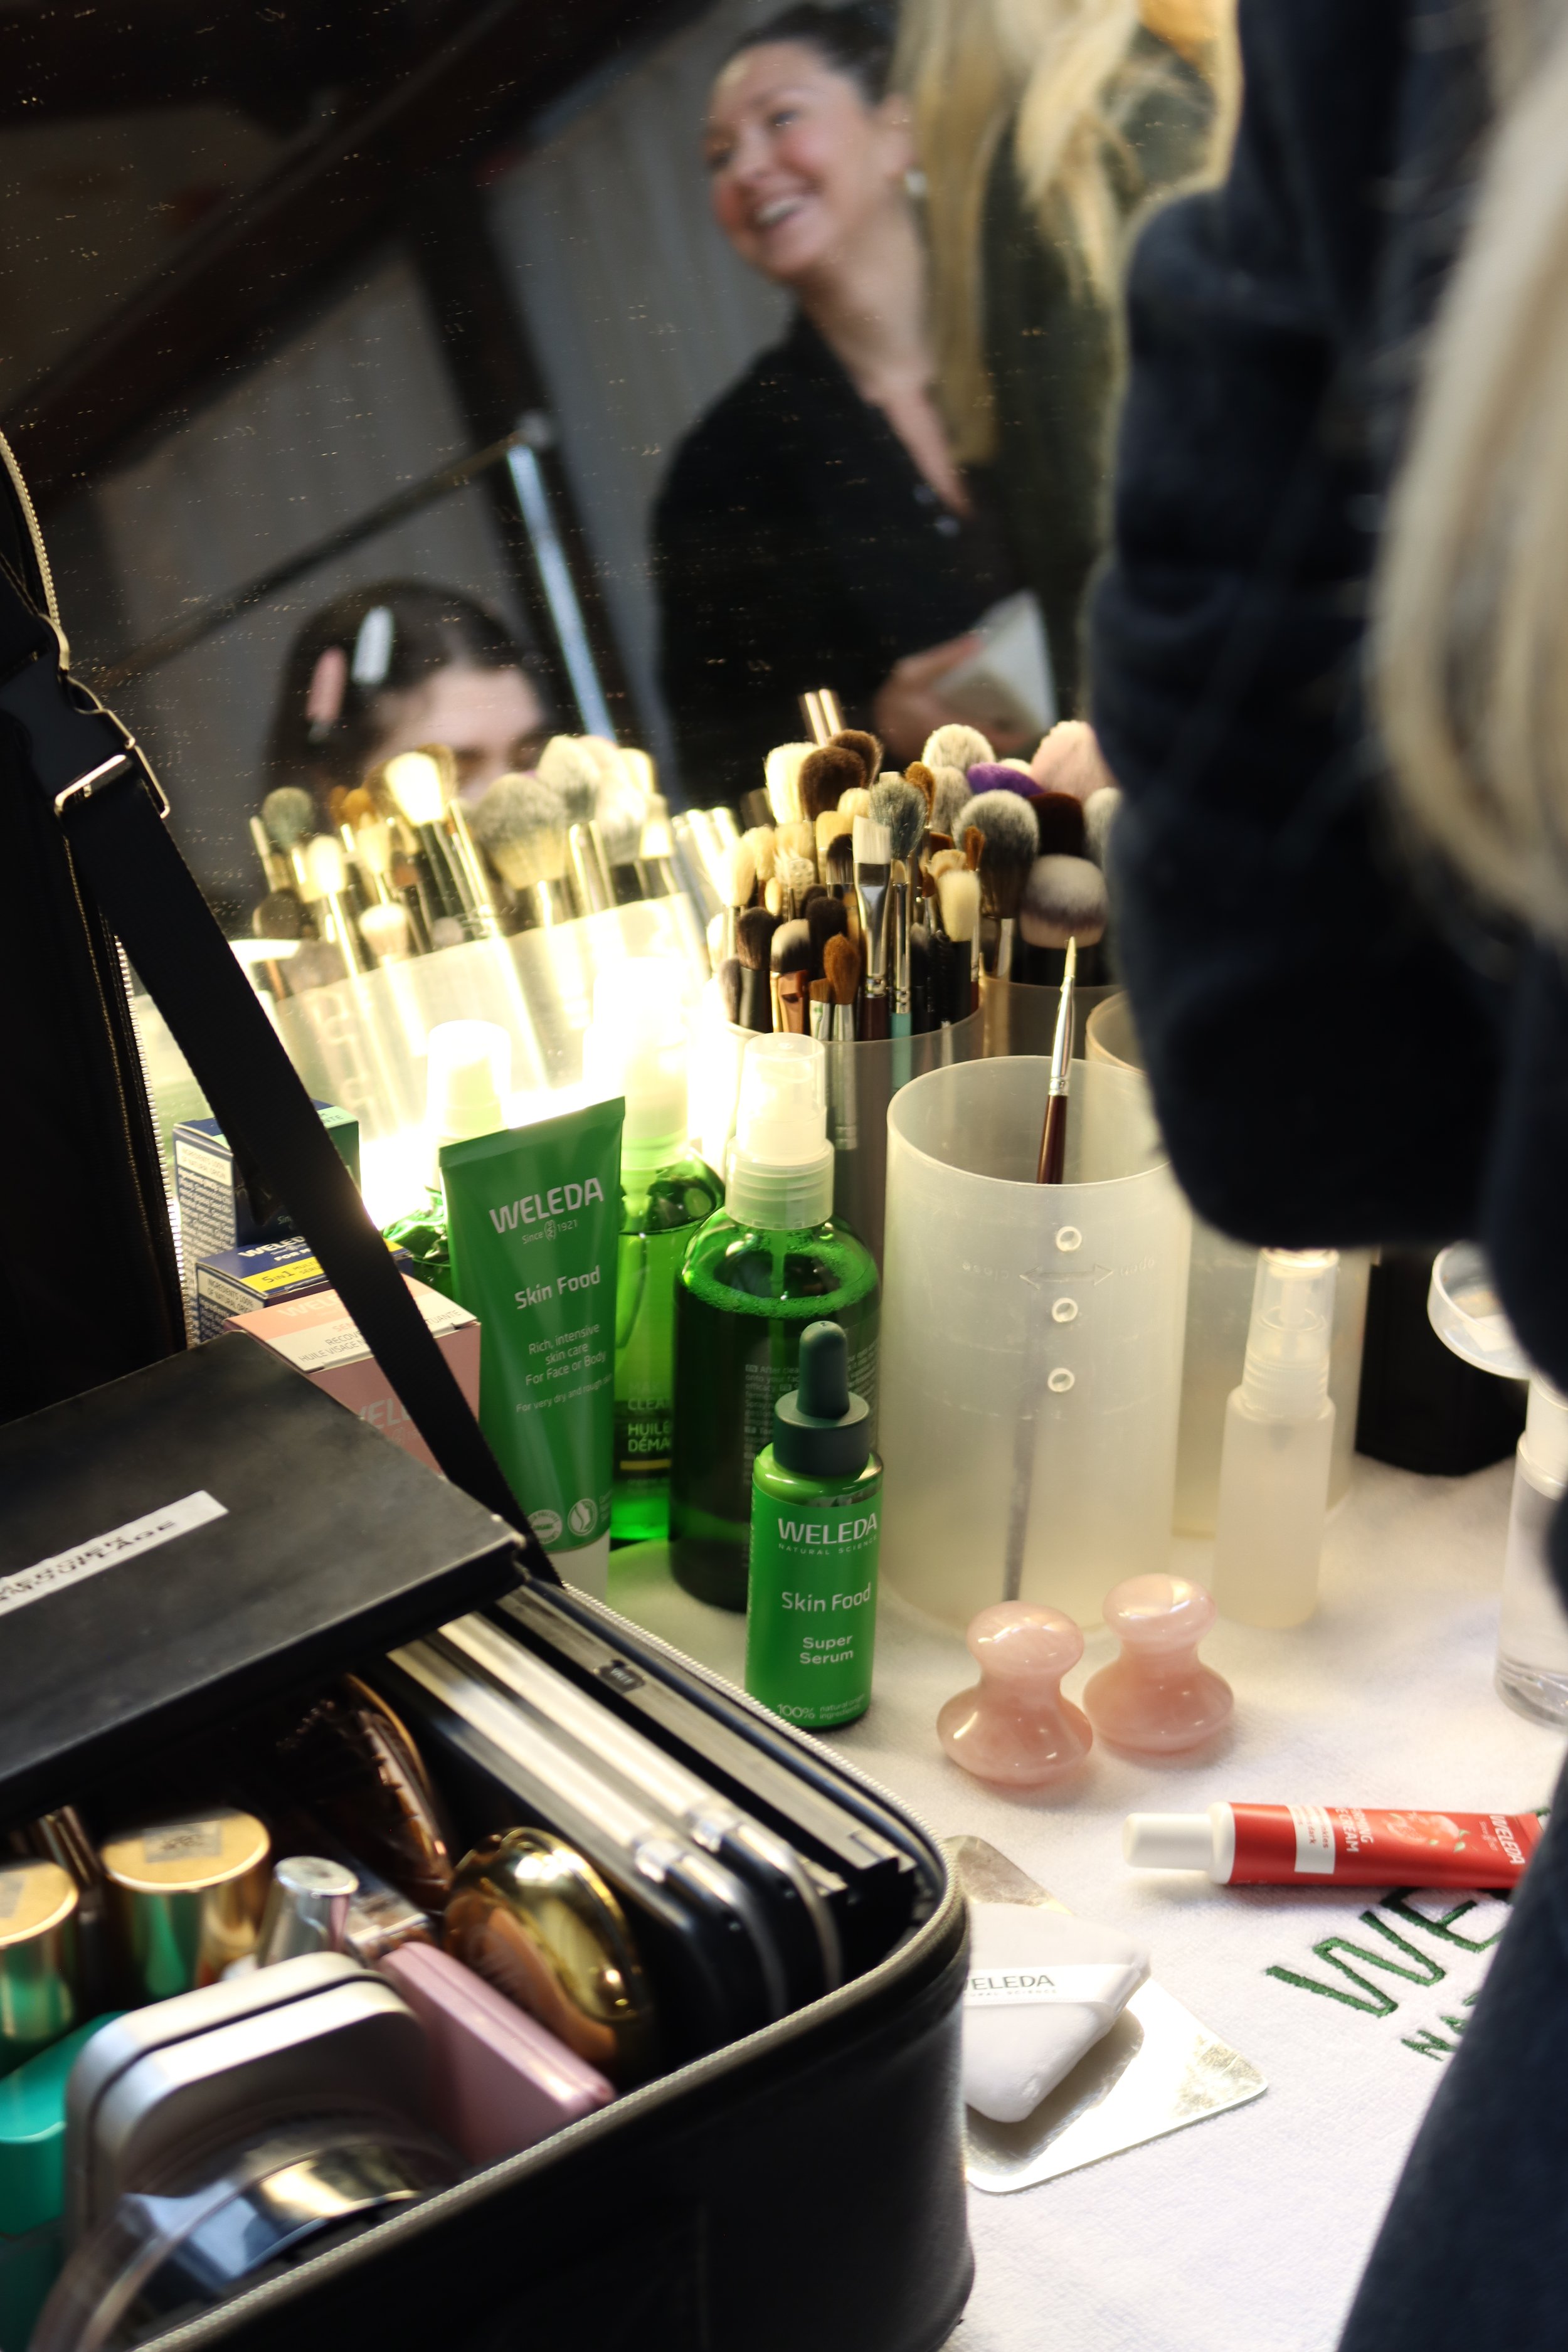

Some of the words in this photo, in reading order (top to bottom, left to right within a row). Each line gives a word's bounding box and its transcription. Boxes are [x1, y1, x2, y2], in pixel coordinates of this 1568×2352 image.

[489, 1177, 605, 1234] WELEDA
[522, 1231, 544, 1244] Since
[556, 1219, 578, 1232] 1921
[514, 1283, 553, 1310] Skin
[556, 1264, 600, 1295] Food
[298, 1348, 326, 1363] HUILE
[325, 1339, 359, 1355] VISAGE
[528, 1339, 554, 1355] Rich,
[554, 1323, 600, 1347] intensive
[544, 1350, 566, 1365] skin
[567, 1342, 590, 1357] care
[525, 1373, 544, 1385] For
[546, 1364, 570, 1380] Face
[571, 1360, 583, 1371] or
[583, 1350, 608, 1368] Body
[516, 1402, 532, 1412] For
[533, 1397, 553, 1409] very
[553, 1392, 568, 1404] dry
[568, 1386, 583, 1399] and
[628, 1398, 670, 1411] CLEA
[628, 1434, 670, 1453] DÉMA
[778, 1512, 878, 1544] WELEDA
[778, 1543, 830, 1555] NATURAL
[838, 1534, 877, 1554] SCIENCE
[781, 1591, 826, 1612] Skin
[832, 1581, 872, 1611] Food
[802, 1635, 853, 1650] Super
[799, 1650, 854, 1665] Serum
[777, 1703, 816, 1720] 100%
[820, 1700, 848, 1712] natural
[1307, 1826, 1316, 1845] dark
[1338, 1813, 1360, 1853] CREAM
[1489, 1814, 1526, 1865] WELEDA
[963, 1974, 1055, 1991] ELEDA
